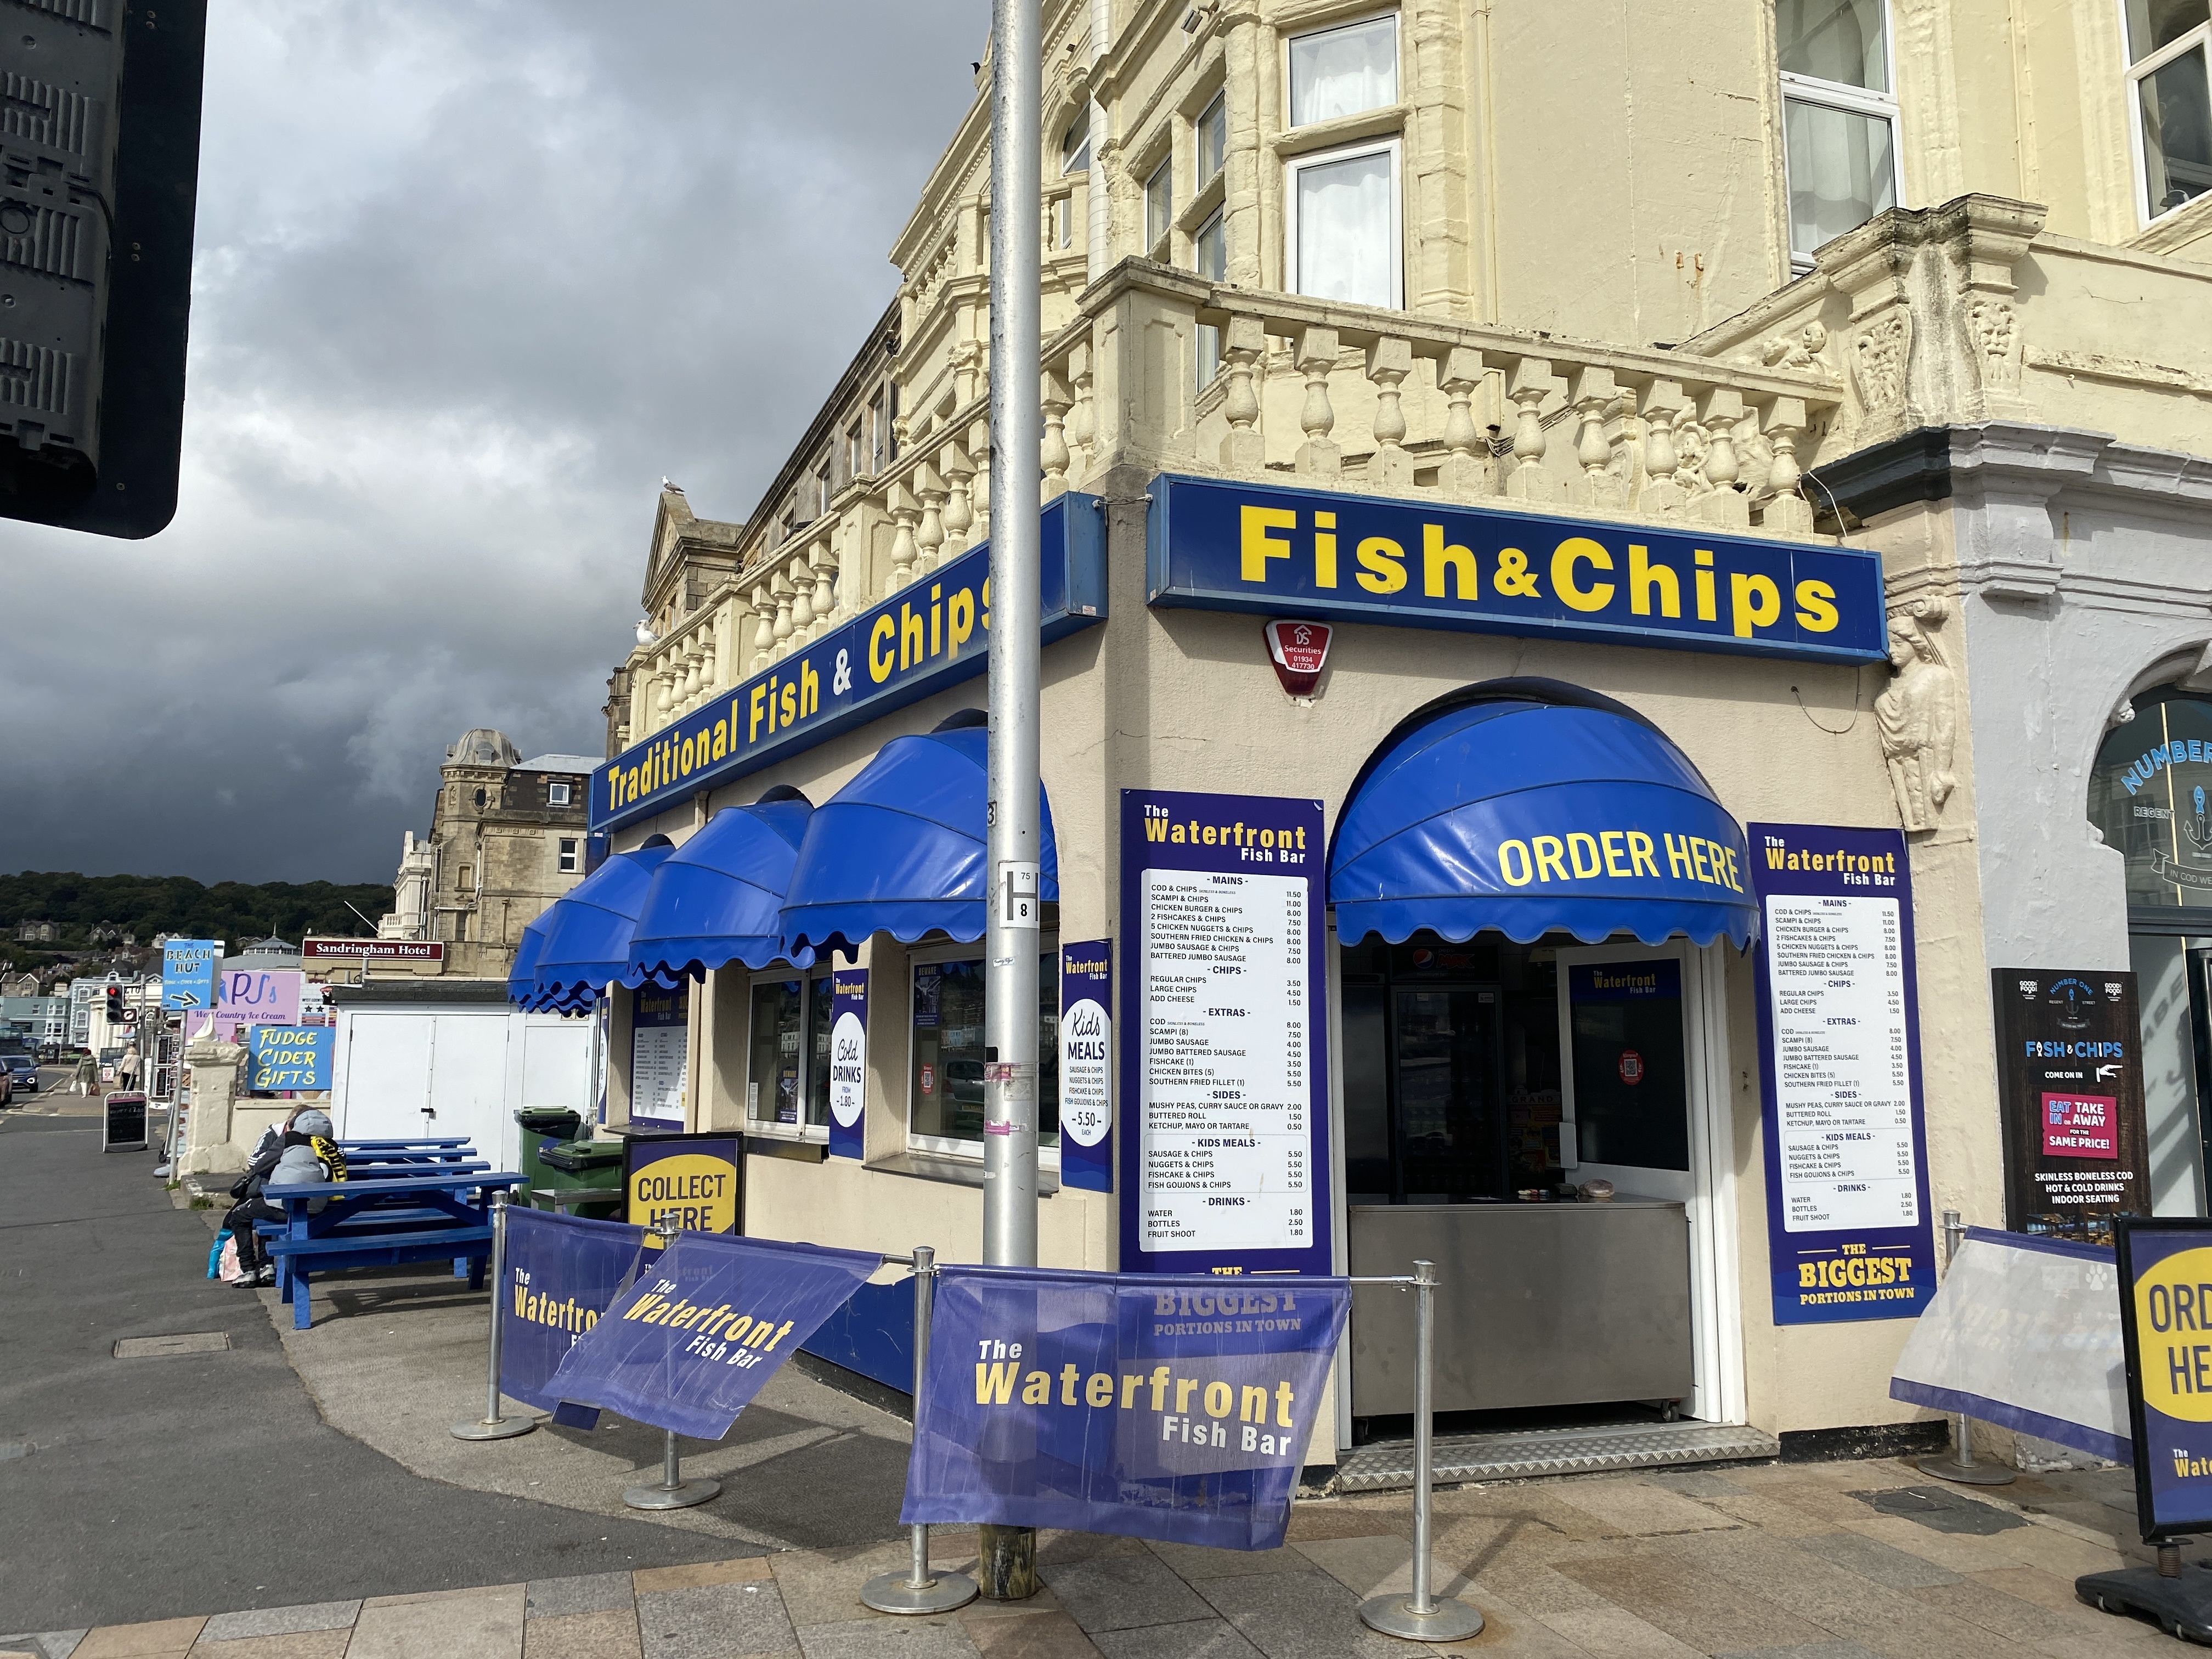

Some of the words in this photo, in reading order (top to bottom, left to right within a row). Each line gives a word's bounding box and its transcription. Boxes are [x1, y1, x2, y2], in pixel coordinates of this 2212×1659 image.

[1284, 645, 1322, 654] Securities
[608, 698, 738, 811] Traditional
[749, 658, 819, 743] Fish
[833, 648, 852, 696] &
[1144, 804, 1169, 817] The
[2134, 806, 2175, 820] REGENT
[1144, 818, 1306, 849] Waterfront
[1765, 836, 1785, 847] The
[1241, 848, 1273, 862] Fish
[1280, 849, 1305, 864] Bar
[1498, 831, 1661, 887] ORDER
[1663, 833, 1744, 894] HERE
[1765, 848, 1895, 873] Waterfront
[1212, 876, 1243, 885] MAINS
[1843, 873, 1869, 885] Fish
[1875, 874, 1895, 885] Bar
[2170, 869, 2179, 878] IN
[2180, 872, 2198, 883] COD
[1020, 904, 1028, 916] 8
[166, 948, 211, 961] BEACH
[316, 943, 394, 957] Sandringham
[398, 945, 430, 955] Hotel
[174, 962, 200, 974] HUT
[918, 966, 936, 976] BEWARE
[1066, 959, 1108, 974] Waterfront
[836, 982, 864, 995] Waterfront
[1594, 974, 1656, 989] Waterfront
[2050, 978, 2077, 995] NUMBER
[2079, 982, 2094, 996] ONE
[640, 996, 672, 1013] Waterfront
[216, 1011, 246, 1021] Country
[261, 1012, 286, 1020] Cream
[1072, 1008, 1100, 1037] Kids
[259, 1028, 318, 1049] FUDGE
[257, 1048, 317, 1068] CIDER
[837, 1039, 859, 1062] Cold
[1068, 1041, 1105, 1060] MEALS
[2067, 1045, 2073, 1054] &
[2075, 1042, 2123, 1058] CHIPS
[255, 1068, 316, 1089] GIFTS
[833, 1065, 861, 1084] DRINKS
[1074, 1098, 1092, 1106] GOUJONS
[1512, 1095, 1554, 1103] GRAND
[2049, 1101, 2071, 1113] EAT
[2075, 1102, 2104, 1114] TAKE
[2050, 1113, 2062, 1125] IN
[2073, 1114, 2106, 1127] AWAY
[2049, 1136, 2076, 1147] SAME
[2079, 1138, 2109, 1149] PRICE!
[2035, 1172, 2073, 1182] SKINLESS
[2074, 1172, 2115, 1181] BONELESS
[2117, 1171, 2134, 1180] COD
[638, 1174, 726, 1202] COLLECT
[2072, 1184, 2093, 1192] COLD
[2095, 1183, 2124, 1192] DRINKS
[2052, 1195, 2084, 1204] INDOOR
[2085, 1195, 2120, 1203] SEATING
[1842, 1244, 1866, 1255] THE
[515, 1267, 530, 1285] The
[1798, 1258, 1911, 1288] BIGGEST
[651, 1279, 676, 1295] The
[1154, 1288, 1296, 1316] BIGGEST
[1800, 1292, 1861, 1305] PORTIONS
[1863, 1290, 1877, 1301] IN
[1878, 1288, 1915, 1300] TOWN
[515, 1284, 601, 1333] Waterfro
[623, 1292, 794, 1352] Waterfront
[1154, 1321, 1232, 1336] PORTIONS
[1236, 1321, 1252, 1333] IN
[1255, 1318, 1301, 1331] TOWN
[685, 1335, 727, 1363] Fish
[729, 1347, 763, 1370] Bar
[979, 1340, 1022, 1360] The
[975, 1362, 1294, 1428] Waterfront
[1163, 1415, 1226, 1448] Fish
[1242, 1426, 1291, 1457] Bar
[2173, 1448, 2188, 1458] The
